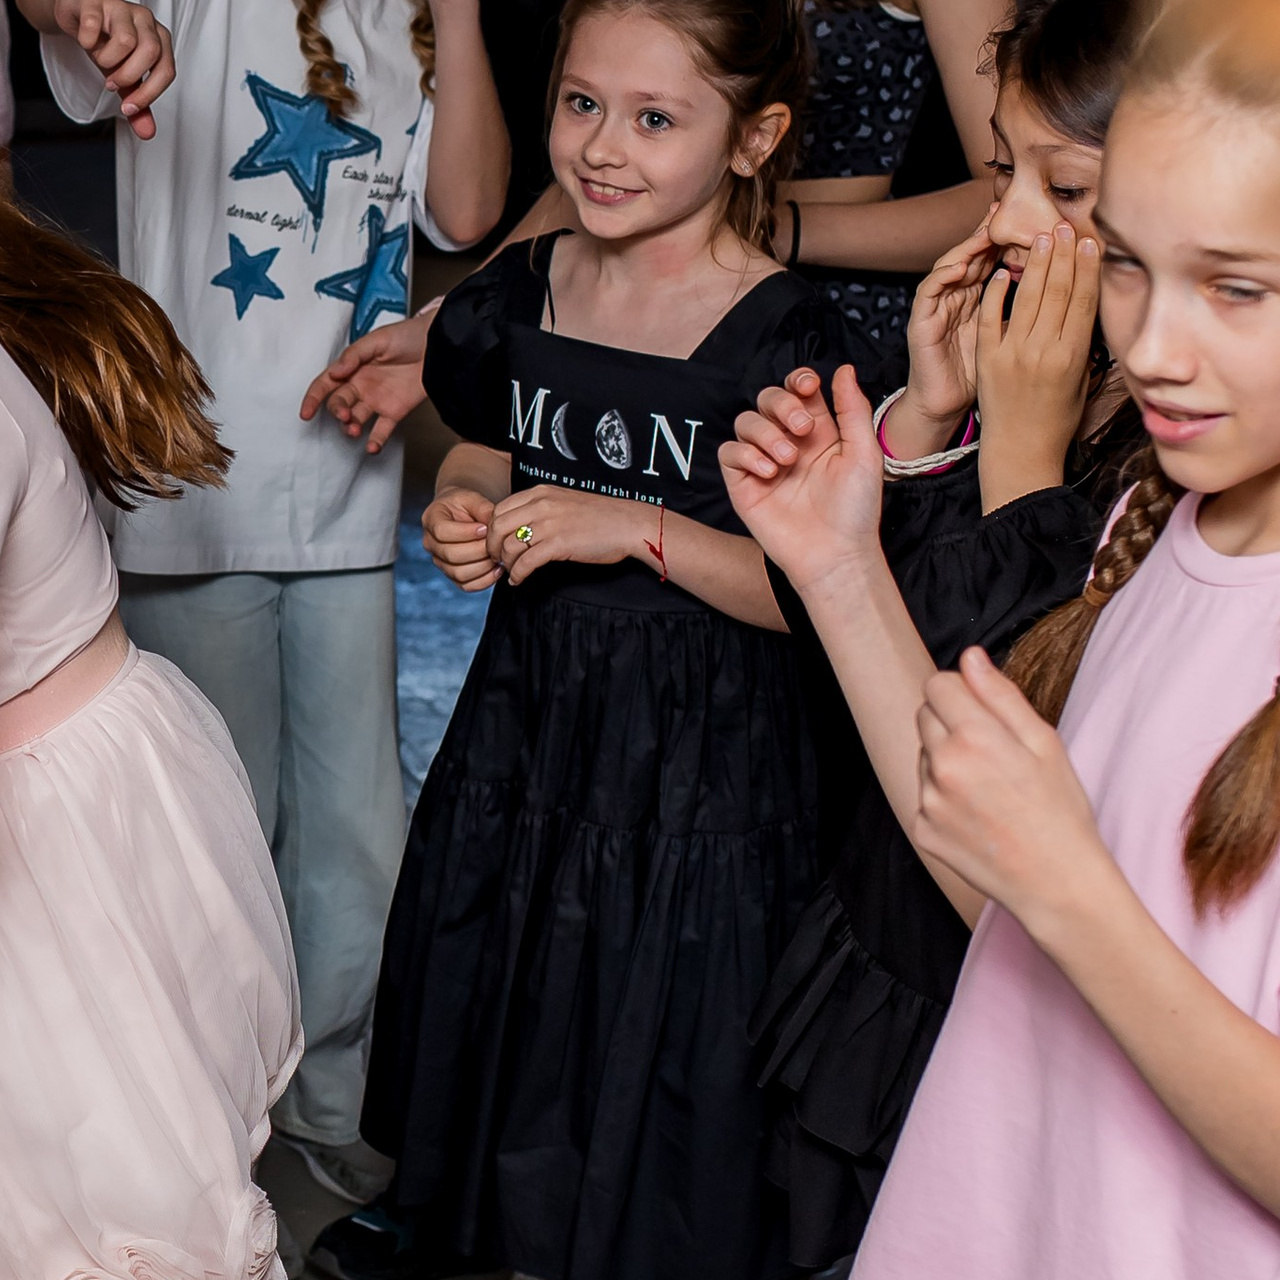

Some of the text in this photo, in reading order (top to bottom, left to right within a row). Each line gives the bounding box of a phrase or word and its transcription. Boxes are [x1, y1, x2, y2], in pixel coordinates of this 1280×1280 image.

[563, 474, 576, 487] up
[581, 479, 596, 491] all
[601, 484, 630, 499] night
[636, 491, 664, 506] long
